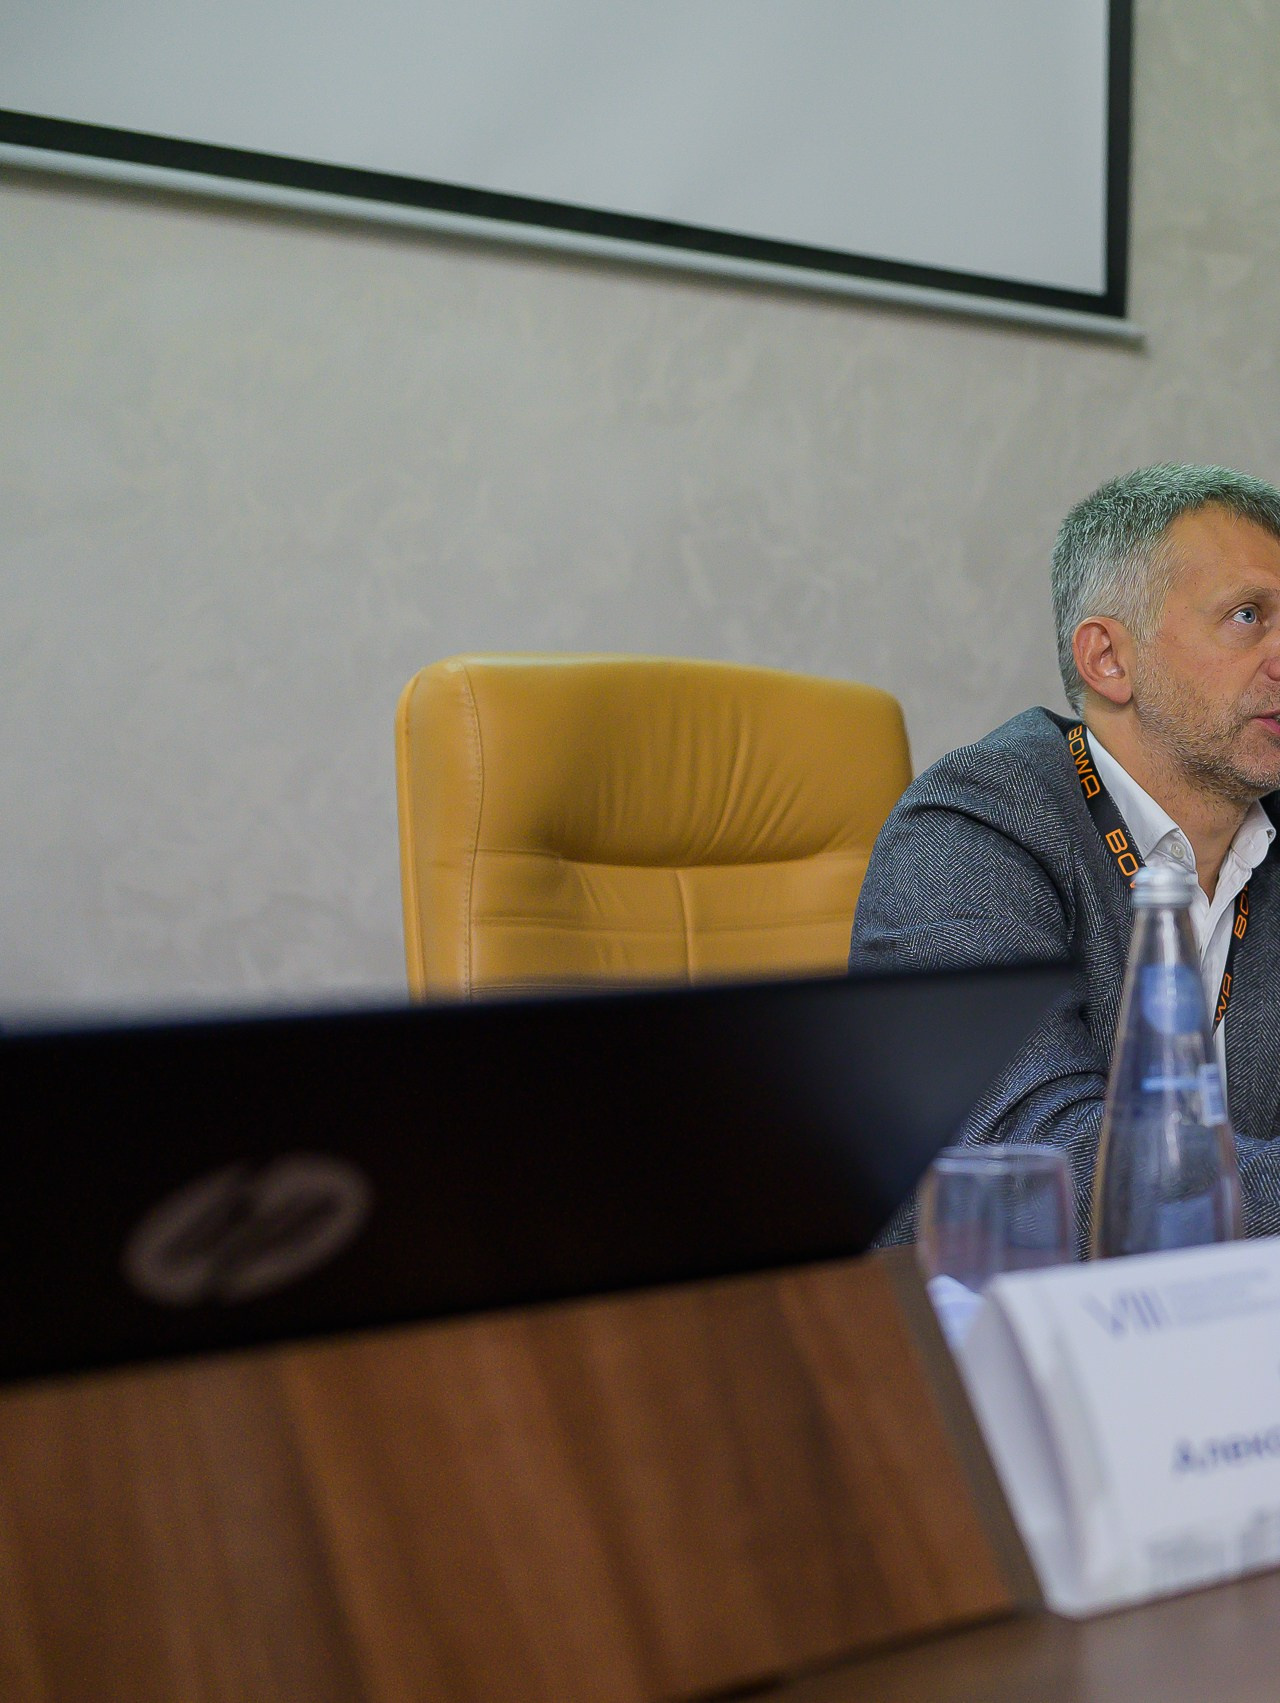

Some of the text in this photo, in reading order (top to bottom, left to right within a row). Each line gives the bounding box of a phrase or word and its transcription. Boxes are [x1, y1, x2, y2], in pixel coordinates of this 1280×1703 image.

[1068, 725, 1100, 799] BOWA
[1105, 828, 1139, 889] BO
[1234, 884, 1249, 940] BO
[1215, 973, 1232, 1021] WA
